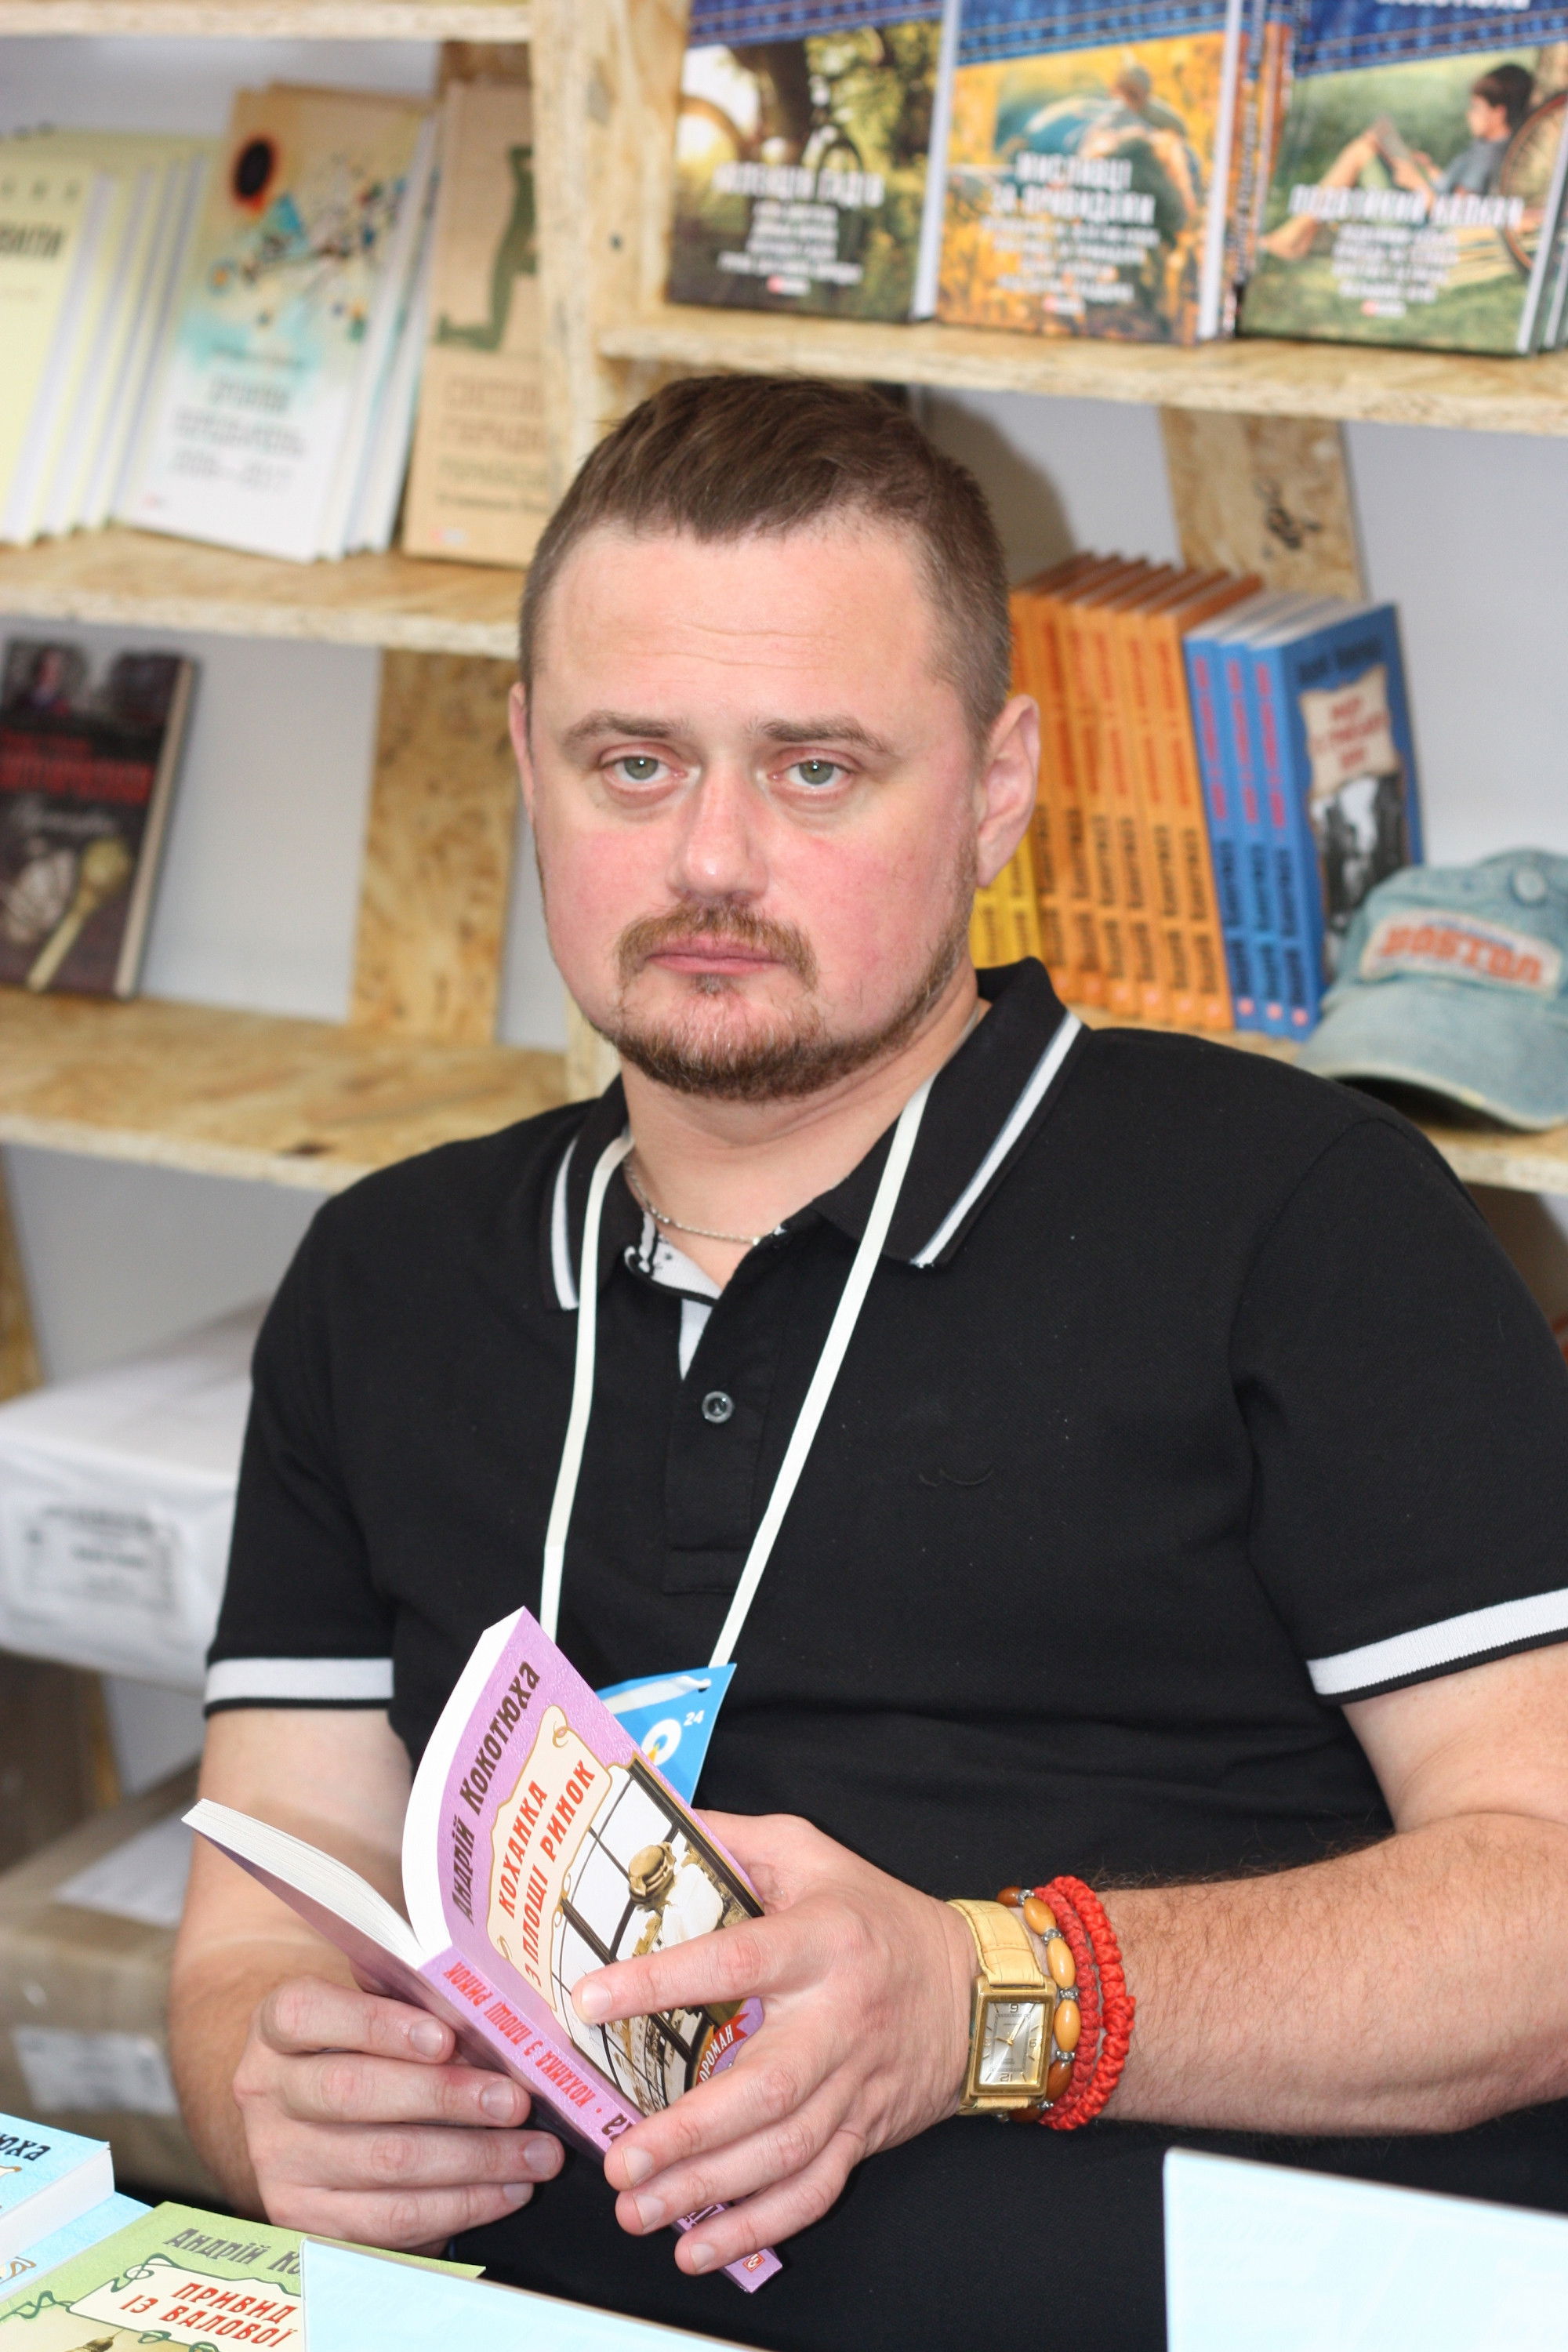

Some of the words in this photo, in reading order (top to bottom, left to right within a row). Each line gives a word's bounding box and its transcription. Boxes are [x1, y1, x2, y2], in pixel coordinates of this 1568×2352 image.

[459, 1661, 541, 1817] Кокотюха
[684, 1710, 705, 1726] 24
[452, 1813, 475, 1926] Андрій
[499, 1780, 548, 1919] КОХАНКА
[522, 1864, 548, 1965] ПЛОЩІ
[539, 1759, 595, 1863] РИНОК
[442, 1961, 494, 2008] РИНОК
[484, 2000, 533, 2045] ПЛОЩІ
[699, 2024, 734, 2082] ОРОМАН
[535, 2049, 596, 2108] КОХАНКА
[0, 2133, 51, 2161] юха
[162, 2227, 271, 2265] Андрій
[158, 2304, 299, 2347] ВАЛОВОЇ
[170, 2282, 299, 2325] ПРИВИД
